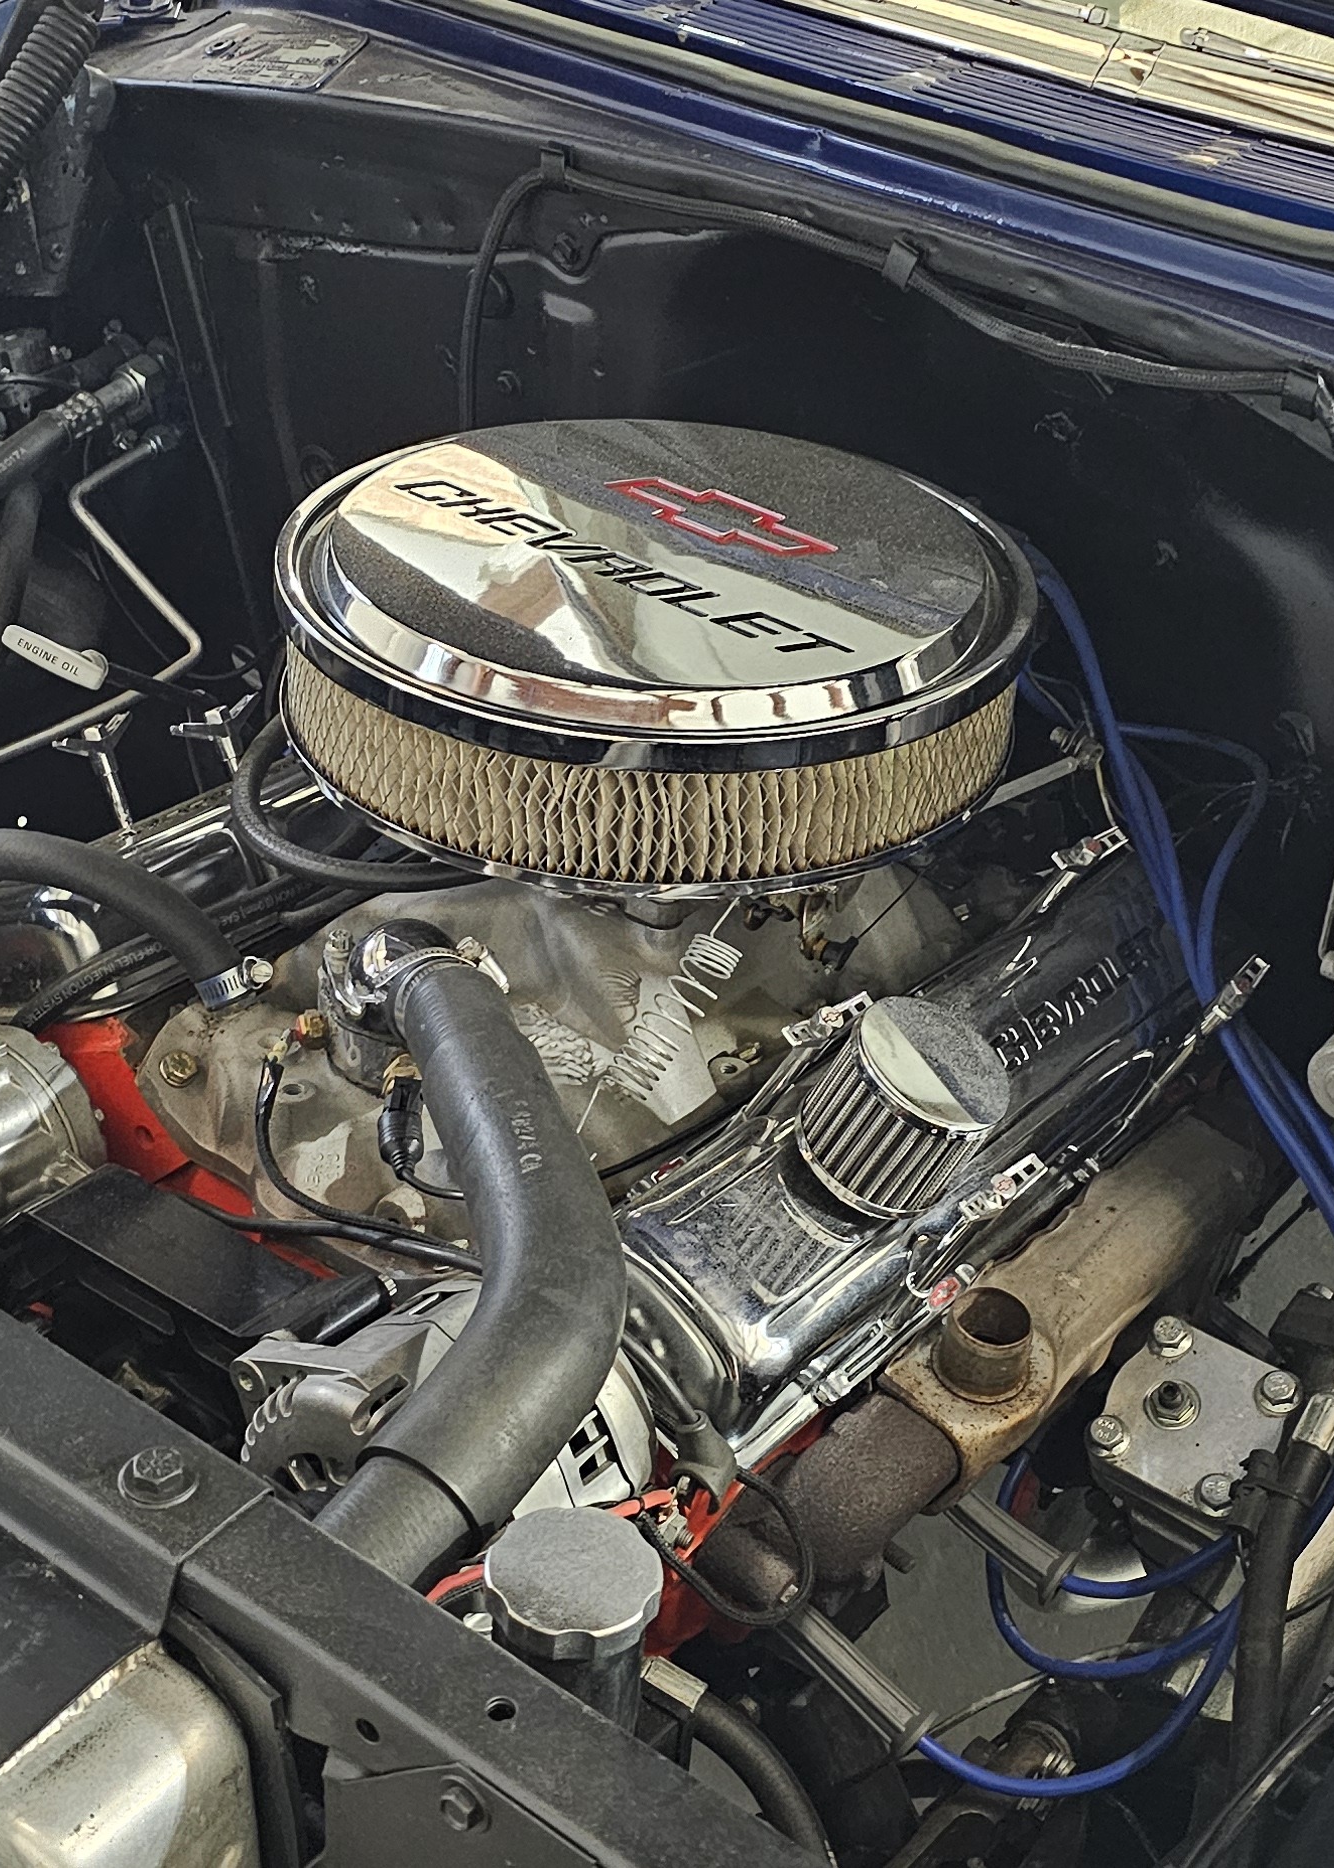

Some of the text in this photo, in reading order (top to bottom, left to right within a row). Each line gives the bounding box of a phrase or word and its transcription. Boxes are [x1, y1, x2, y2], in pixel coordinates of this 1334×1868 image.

[394, 478, 855, 656] CHEVROLET
[16, 637, 80, 677] ENGINE OIL
[118, 951, 145, 967] FUEL
[62, 961, 116, 999] INJECTION
[988, 926, 1159, 1072] CHEVROLET
[23, 993, 63, 1028] SYSTEMS
